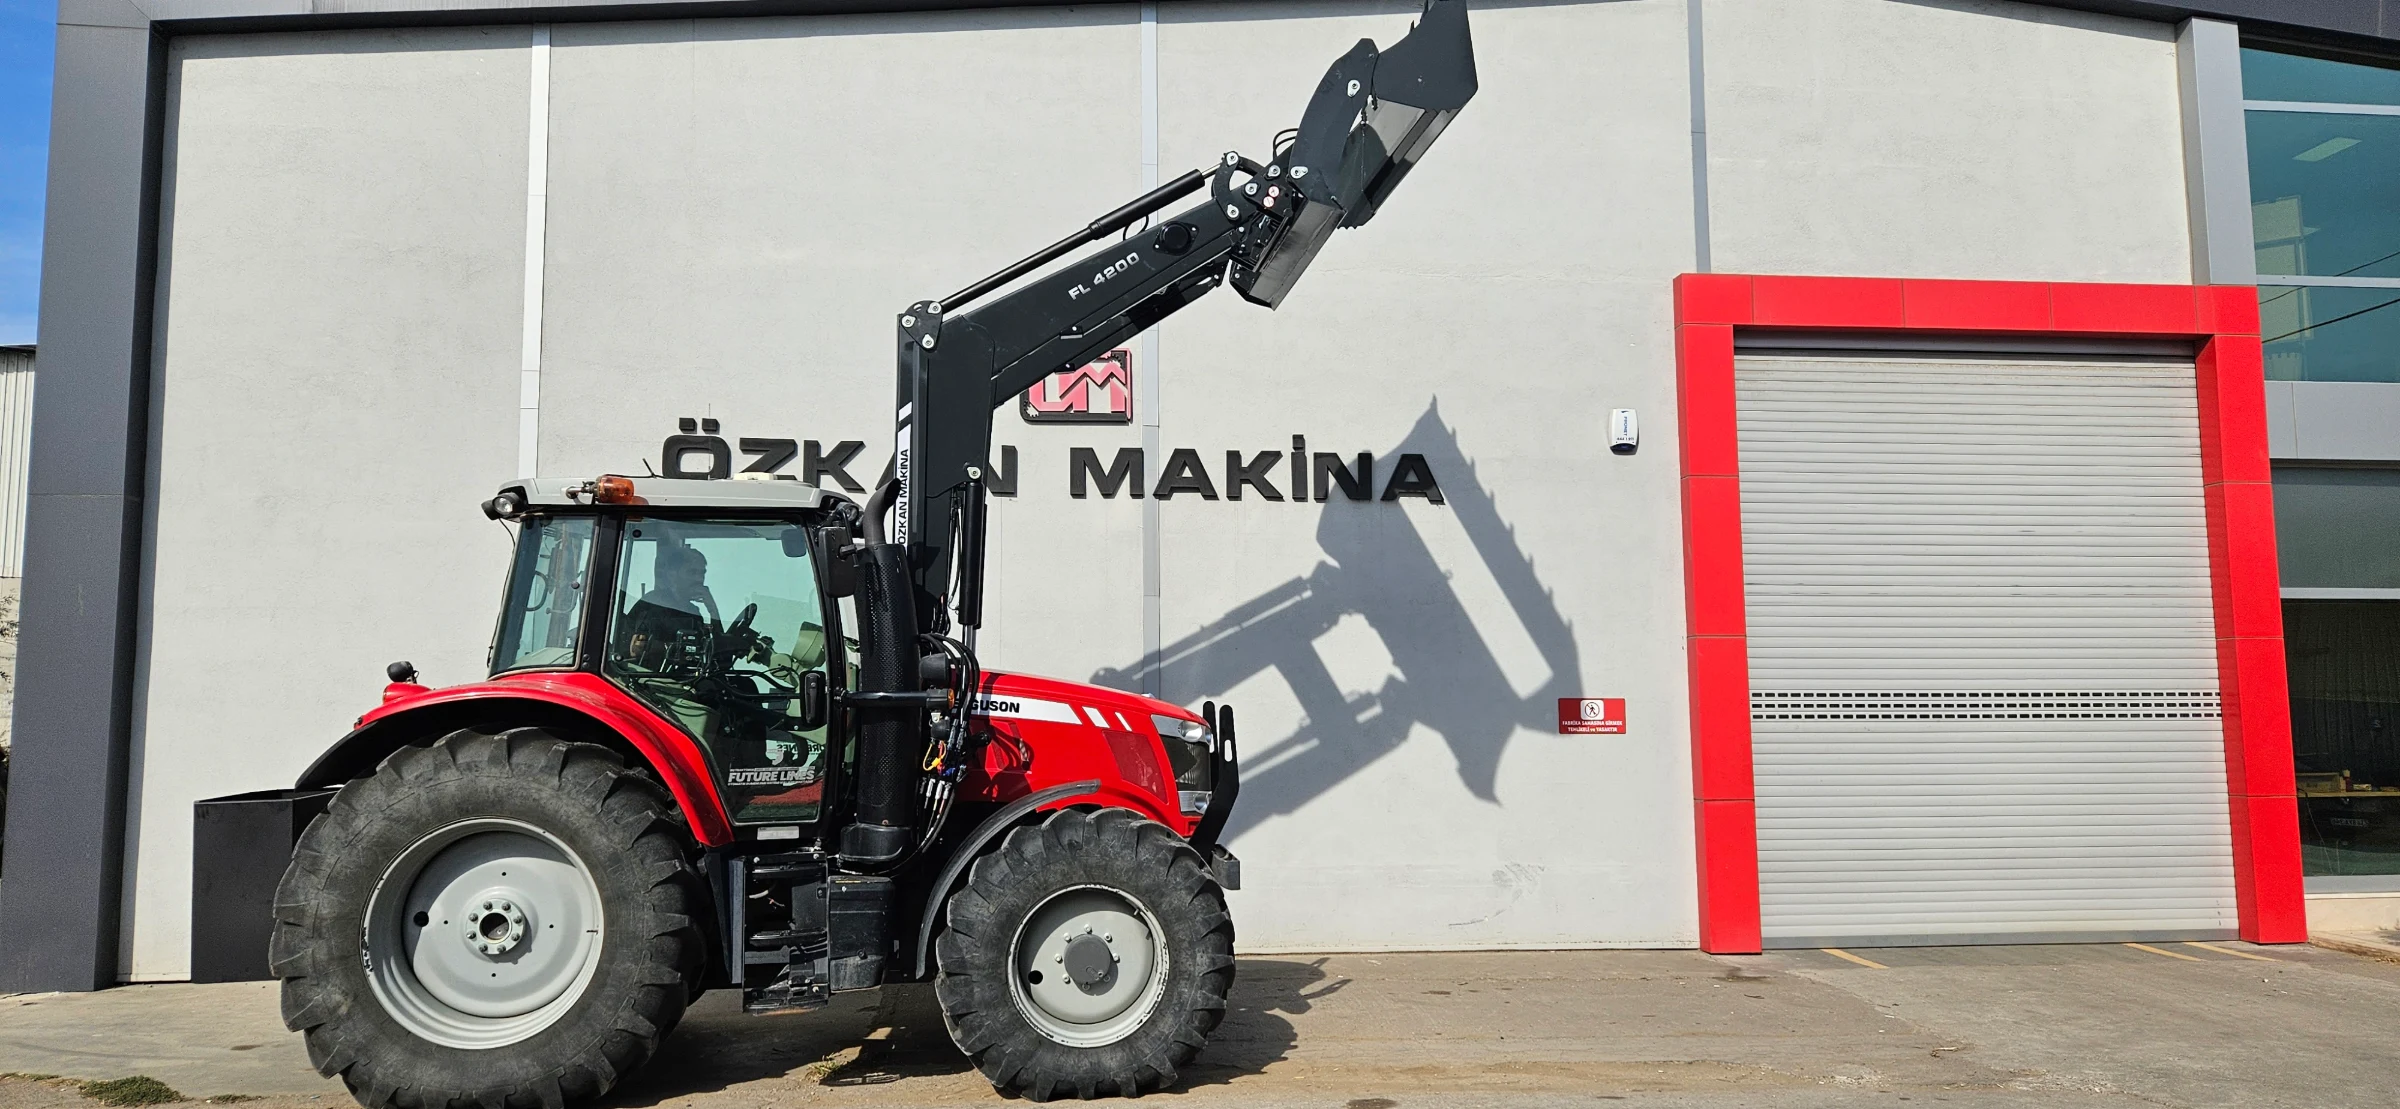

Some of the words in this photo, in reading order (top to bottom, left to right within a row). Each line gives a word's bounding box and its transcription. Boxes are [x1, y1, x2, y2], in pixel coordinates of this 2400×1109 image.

[1068, 284, 1091, 300] FL
[1093, 252, 1140, 285] 4200
[662, 417, 1018, 498] ÖZKN
[1070, 434, 1445, 504] MAKİNA
[898, 448, 909, 499] MAKİNA
[897, 501, 907, 545] ÖZKAN
[954, 699, 1020, 713] GUSON
[728, 771, 778, 783] FUTURE
[779, 770, 815, 781] LINES
